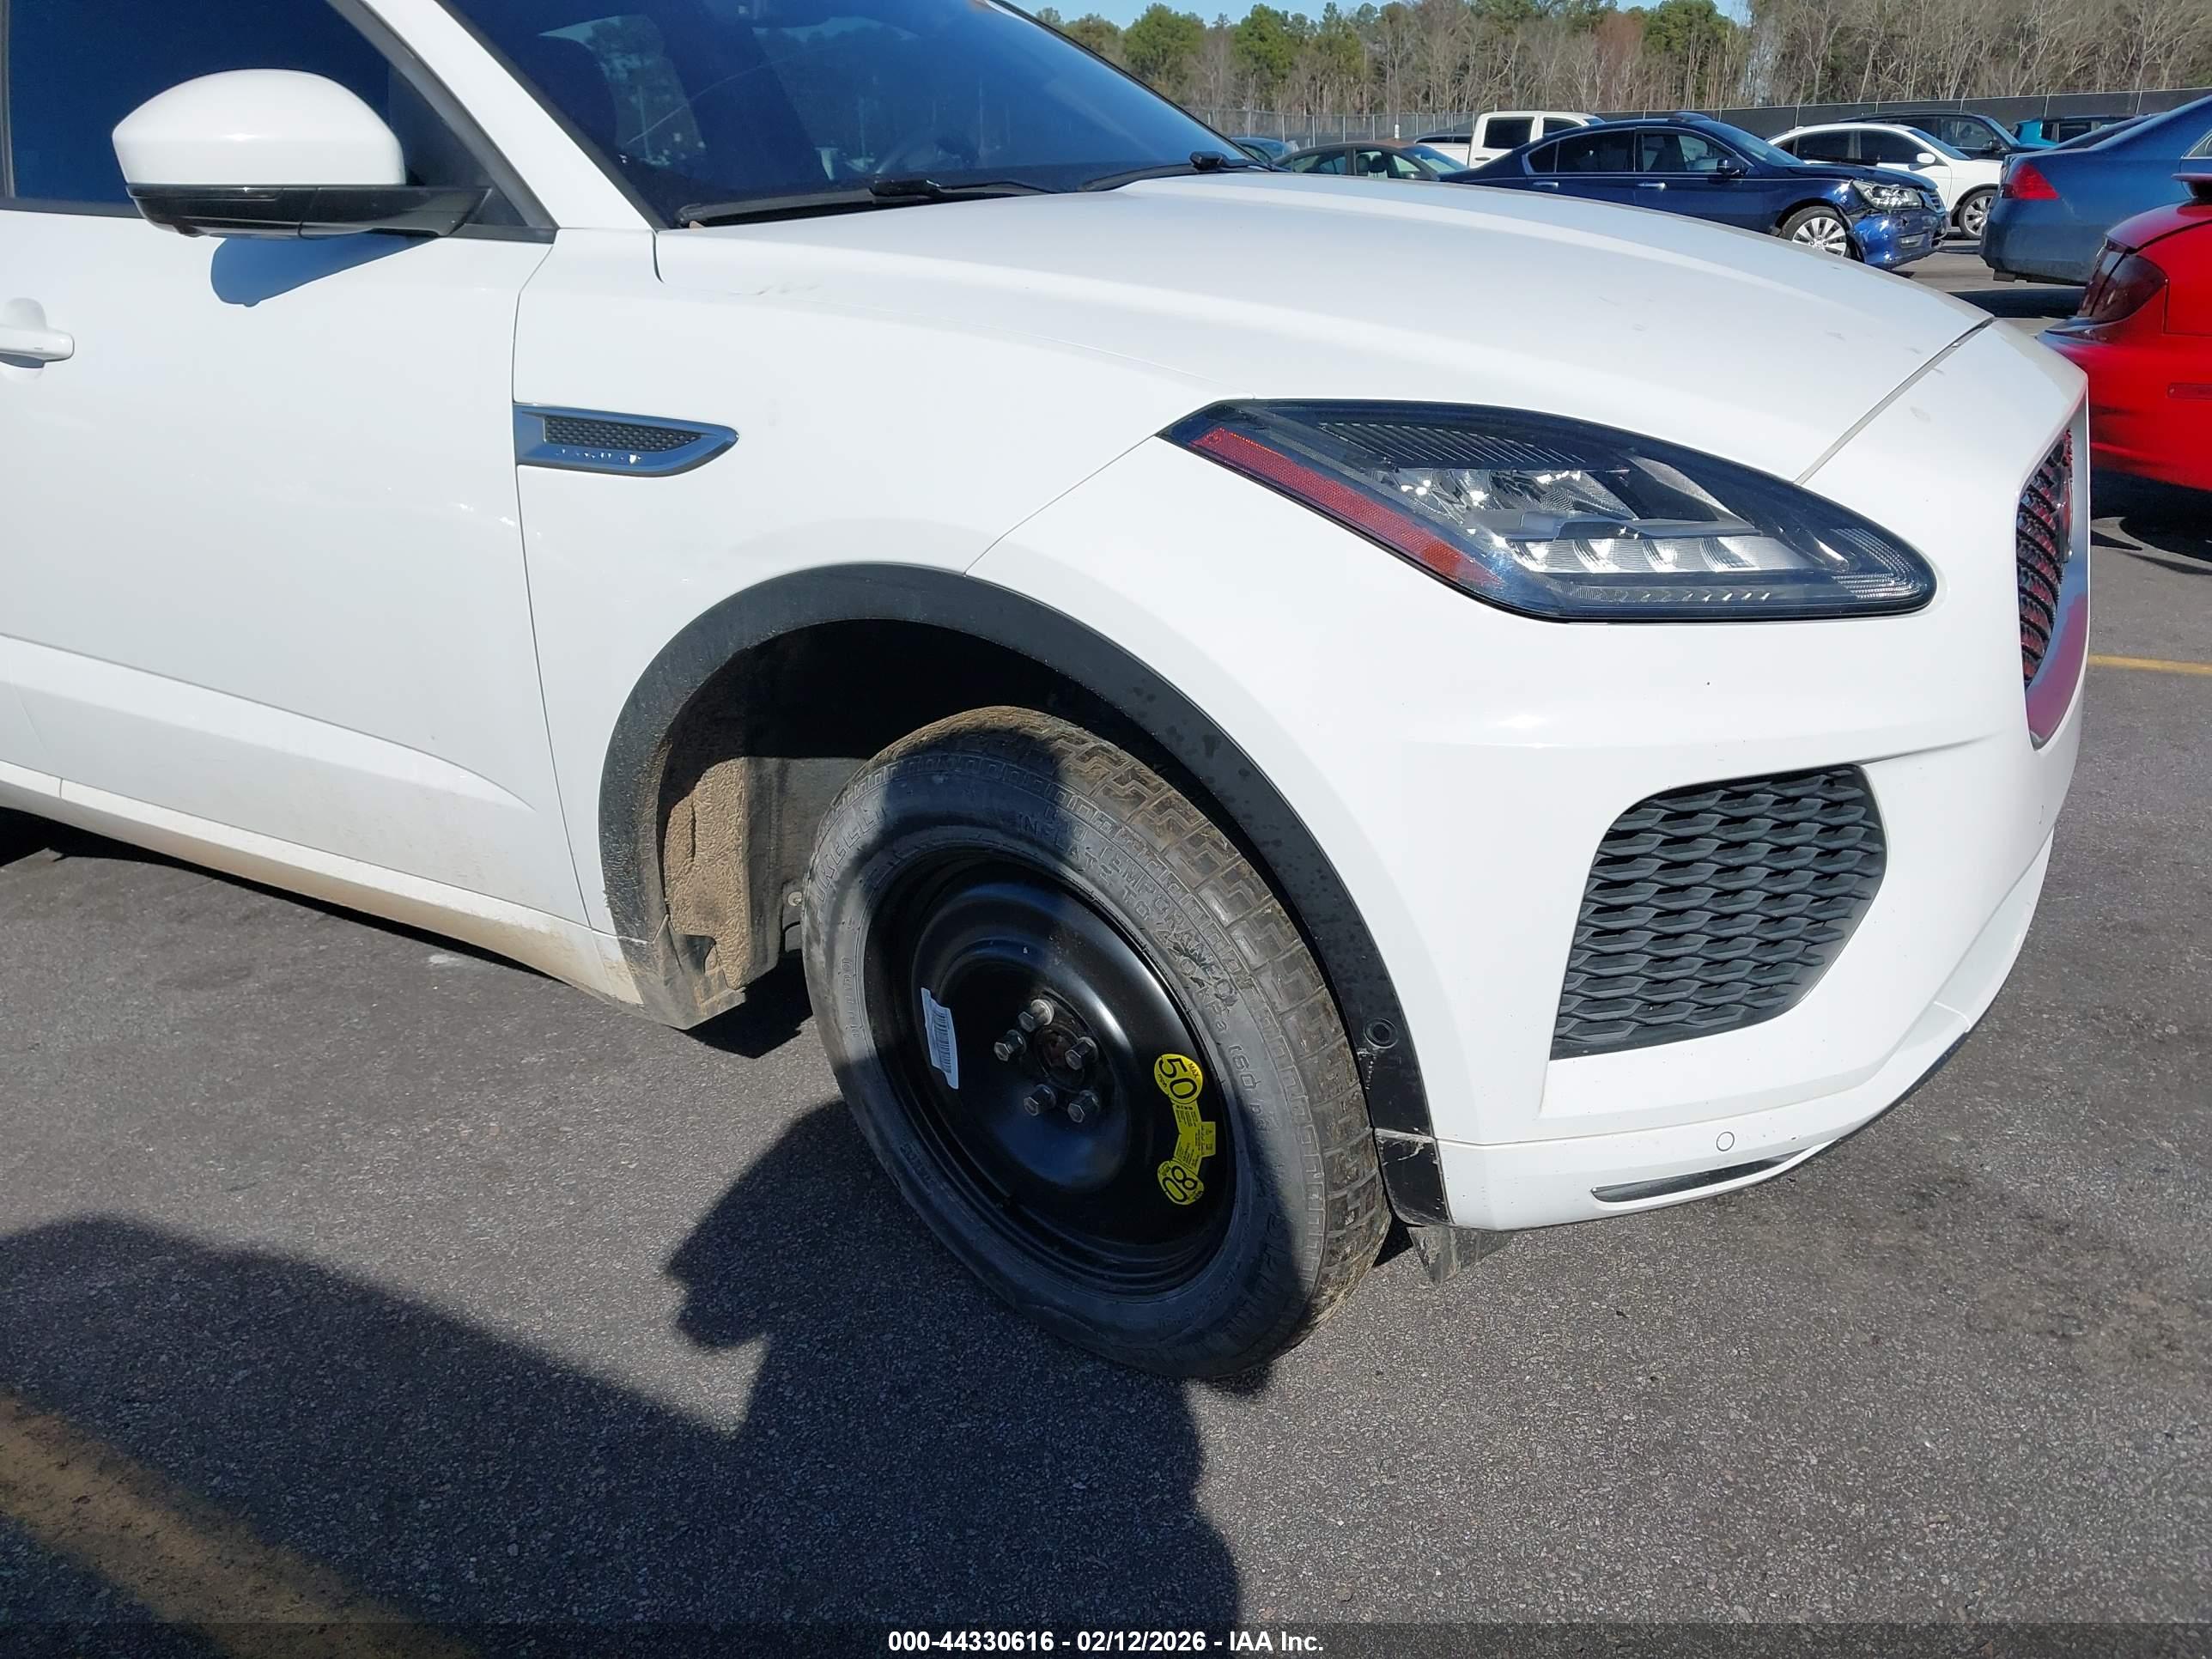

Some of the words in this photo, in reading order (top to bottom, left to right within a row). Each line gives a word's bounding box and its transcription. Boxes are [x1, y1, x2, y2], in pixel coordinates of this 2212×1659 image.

[1158, 1057, 1198, 1100] 50
[1188, 1062, 1200, 1079] MAX
[1162, 1165, 1198, 1202] 80
